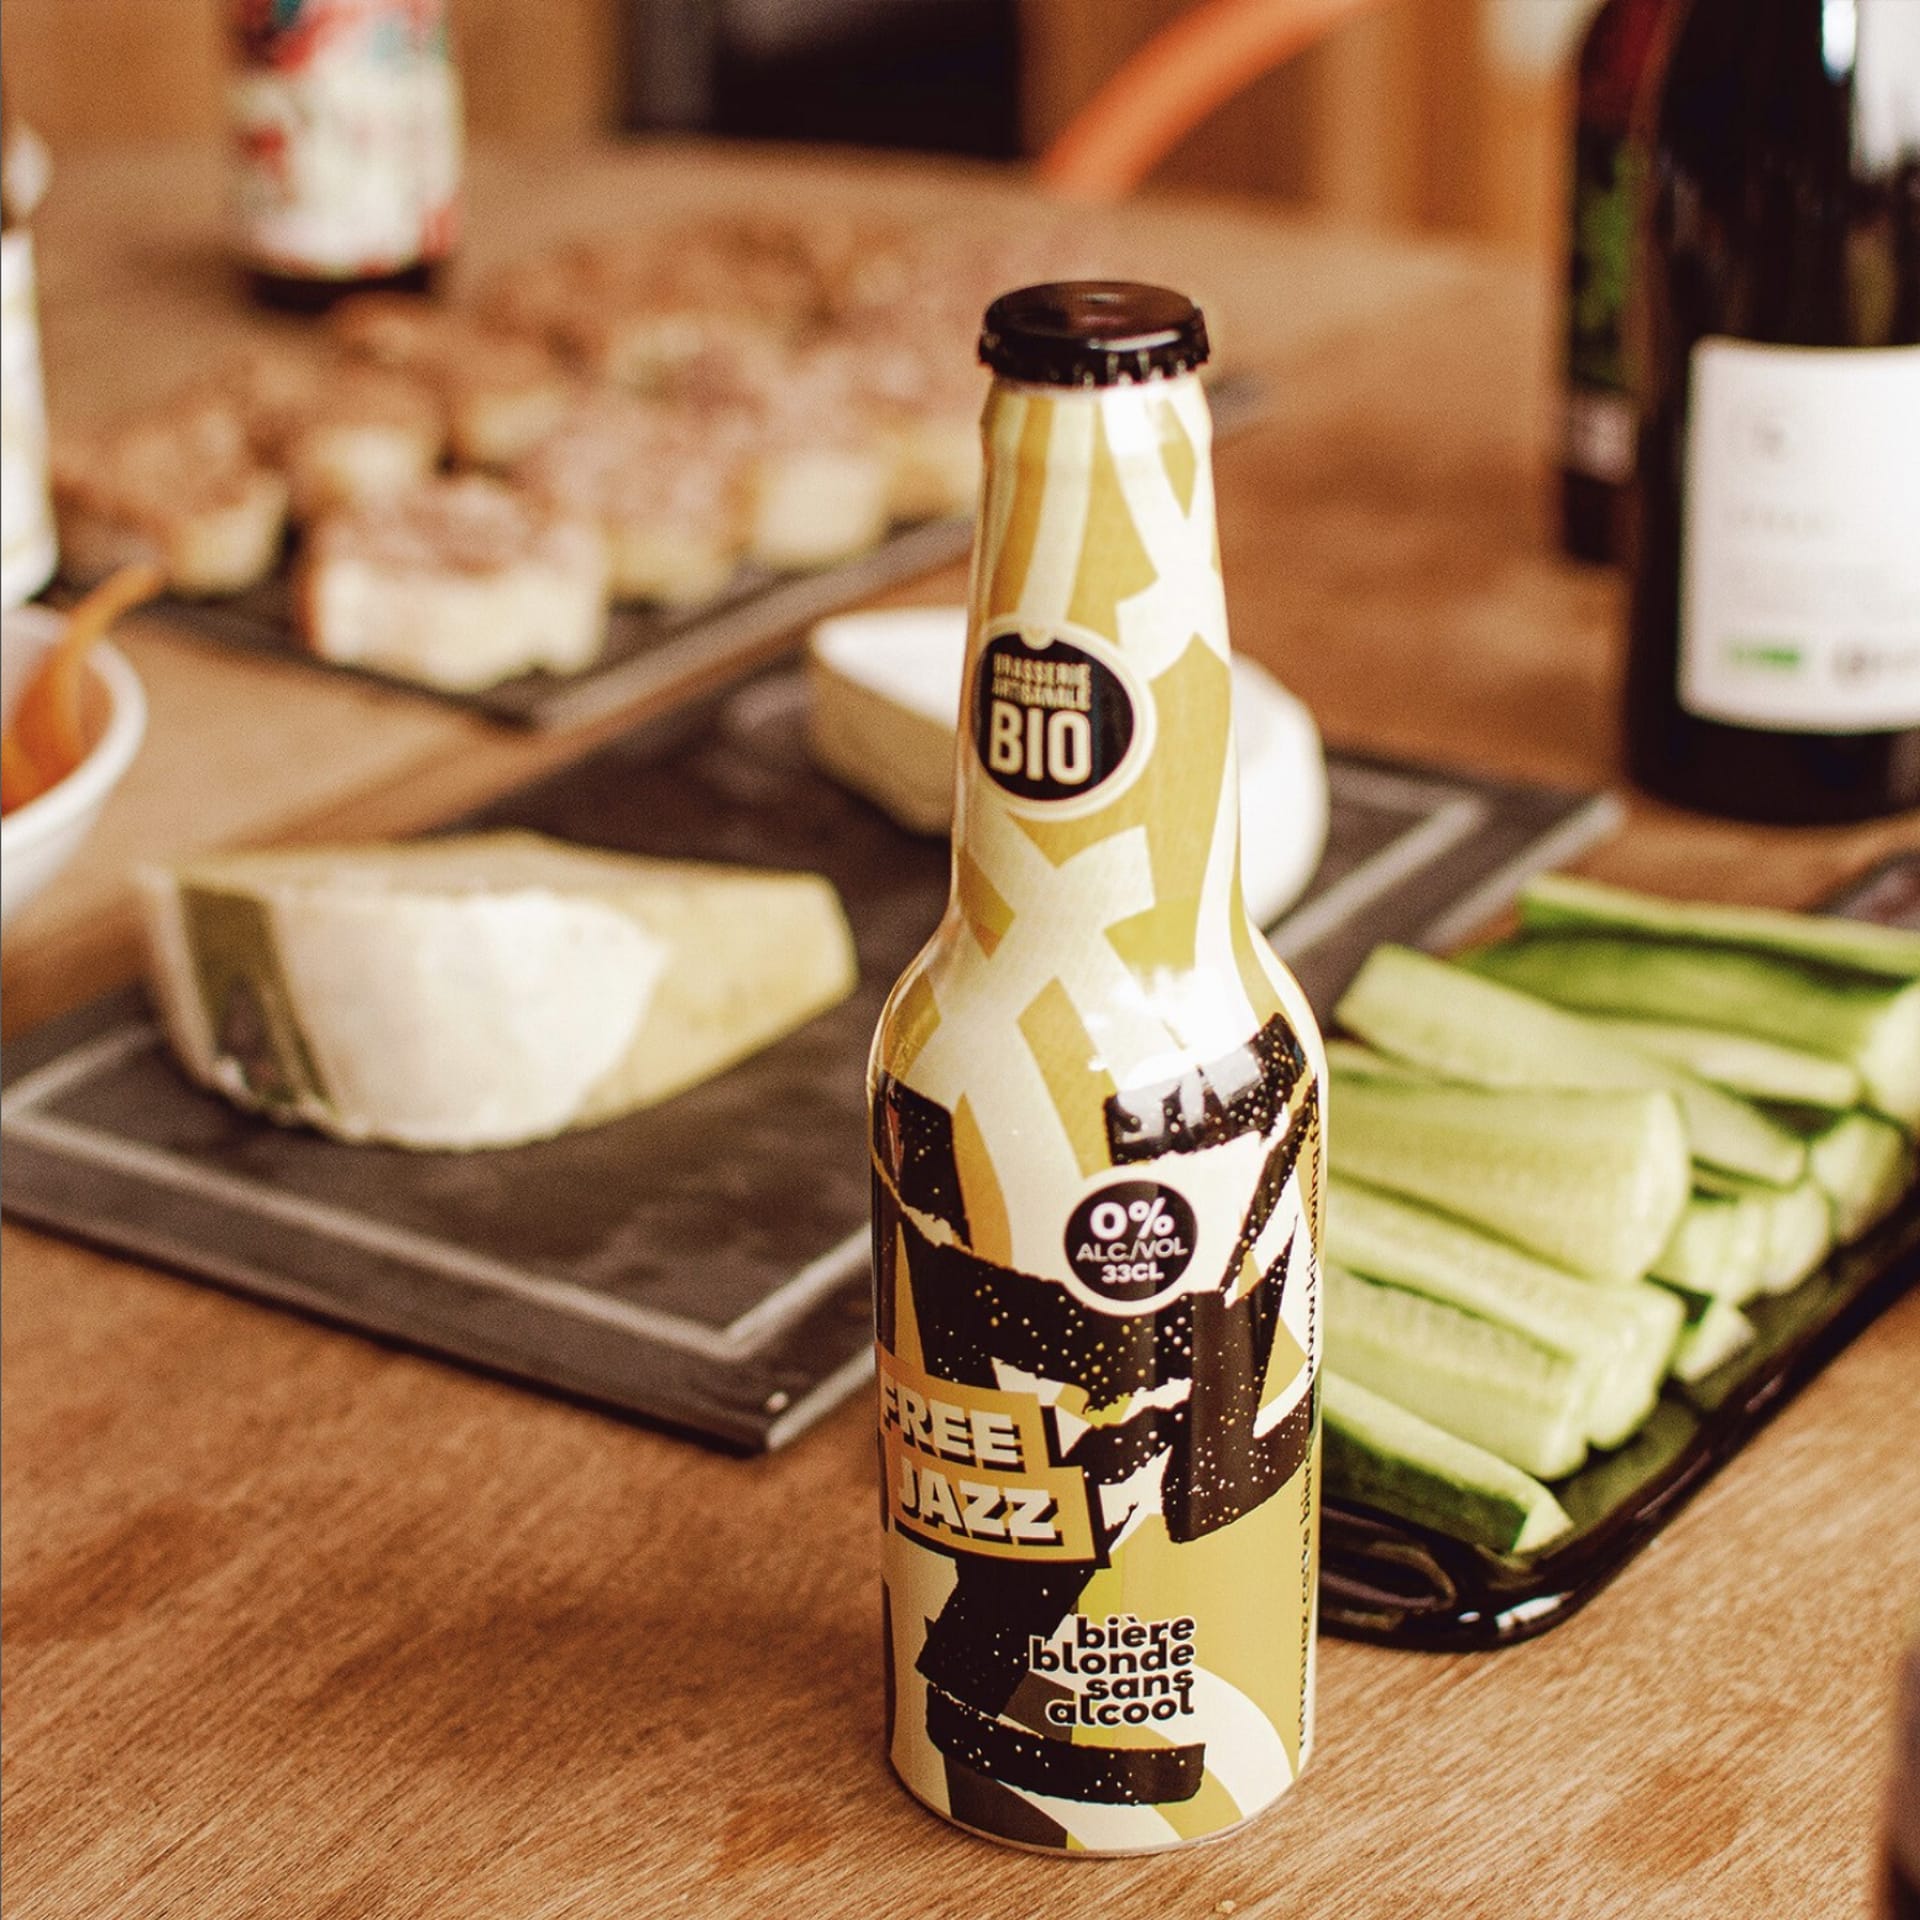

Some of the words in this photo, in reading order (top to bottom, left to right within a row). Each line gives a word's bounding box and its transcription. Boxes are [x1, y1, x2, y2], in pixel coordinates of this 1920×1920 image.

[988, 699, 1092, 785] BIO
[1090, 1197, 1175, 1240] 0%
[1101, 1263, 1165, 1284] 33CL
[880, 1373, 1022, 1469] FREE
[899, 1457, 1060, 1542] JAZZ
[1077, 1616, 1194, 1649] bière
[1032, 1637, 1194, 1674] blonde
[1086, 1669, 1194, 1700] sans
[1048, 1685, 1194, 1725] alcool
